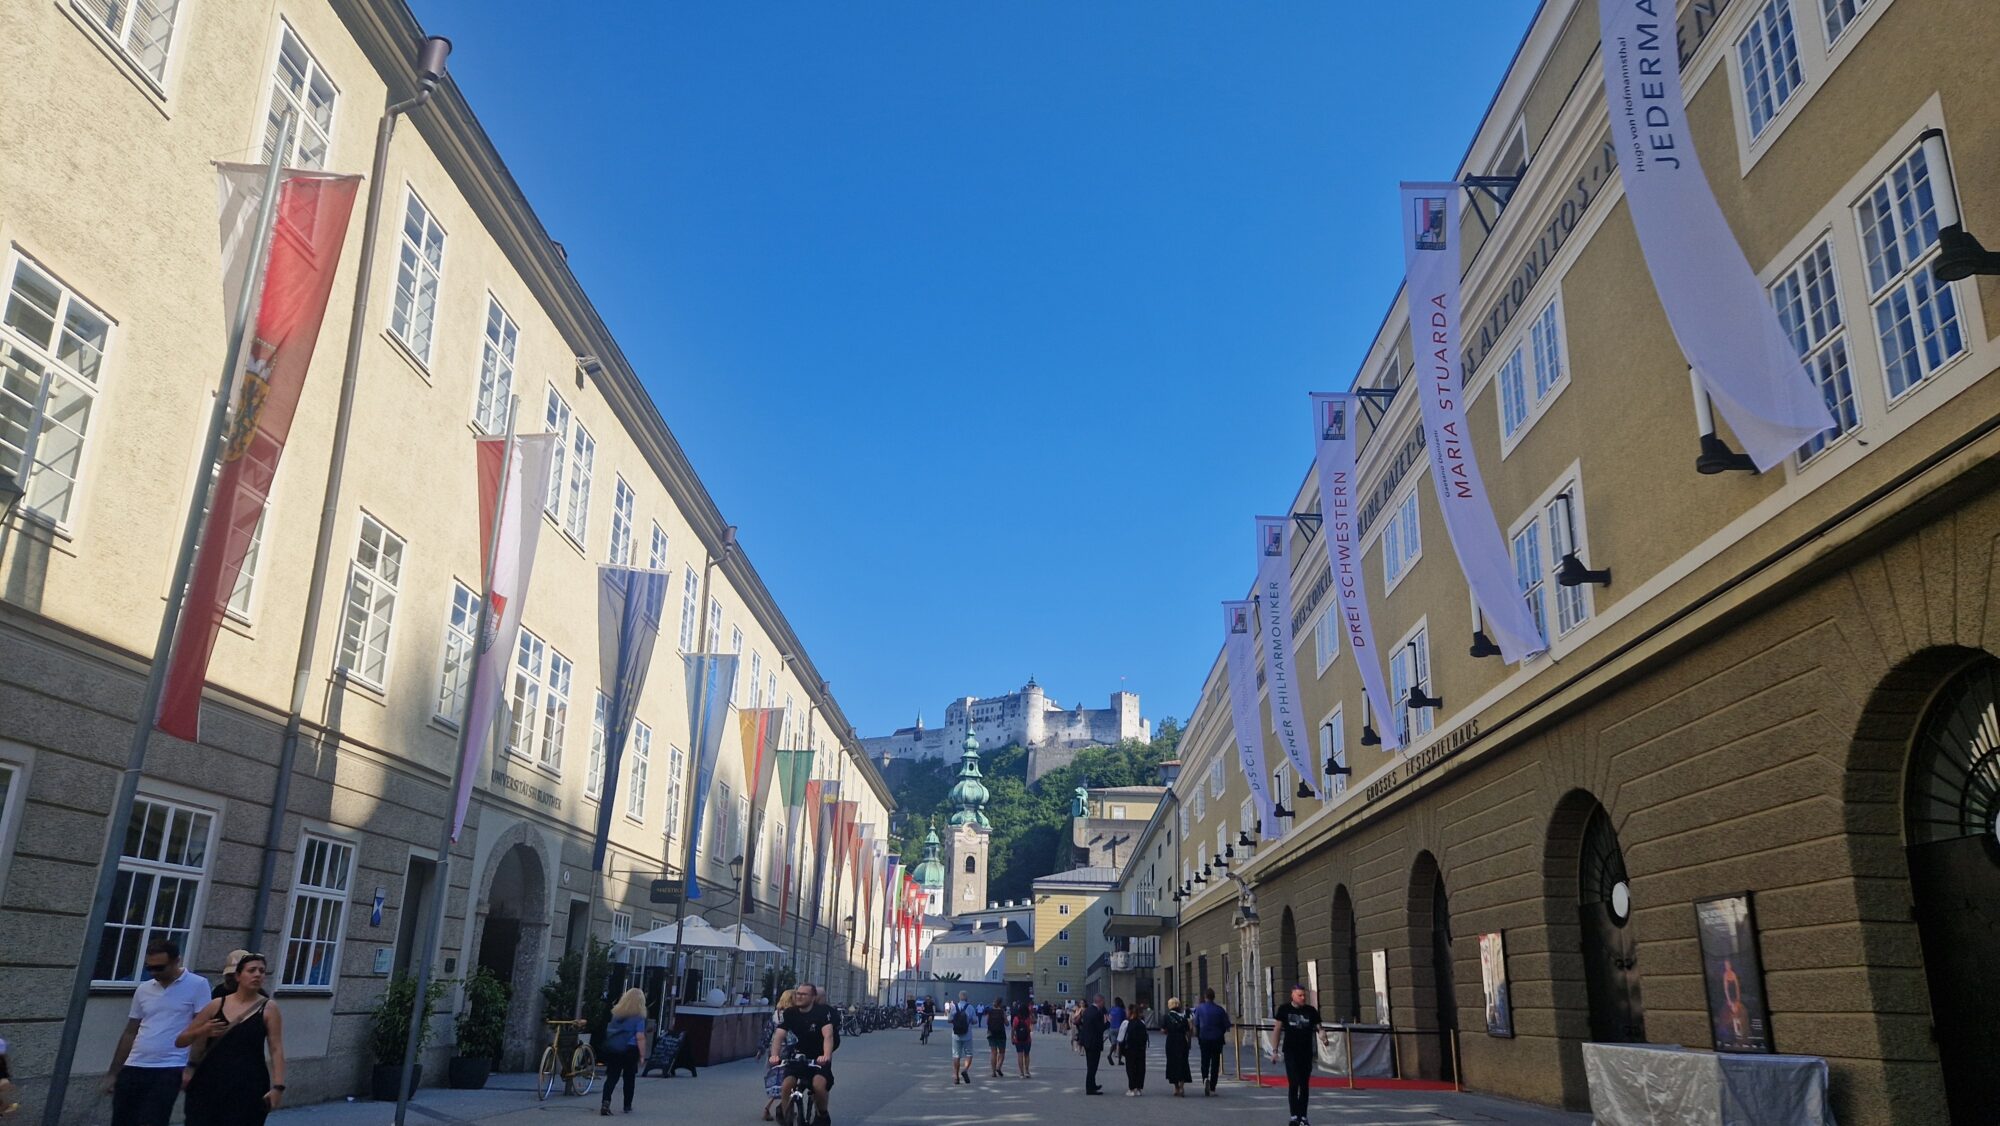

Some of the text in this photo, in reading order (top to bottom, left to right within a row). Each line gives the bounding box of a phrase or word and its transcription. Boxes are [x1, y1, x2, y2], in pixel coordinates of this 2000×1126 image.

[1617, 37, 1645, 172] Hugo von Hofmannsthal
[1431, 293, 1473, 499] MARIA STUARDA
[1333, 471, 1365, 647] DREI SCHWESTERN
[1269, 581, 1291, 714] PHILHARMONIKER
[1366, 719, 1479, 802] GROSSES FESTSPIELHAUS
